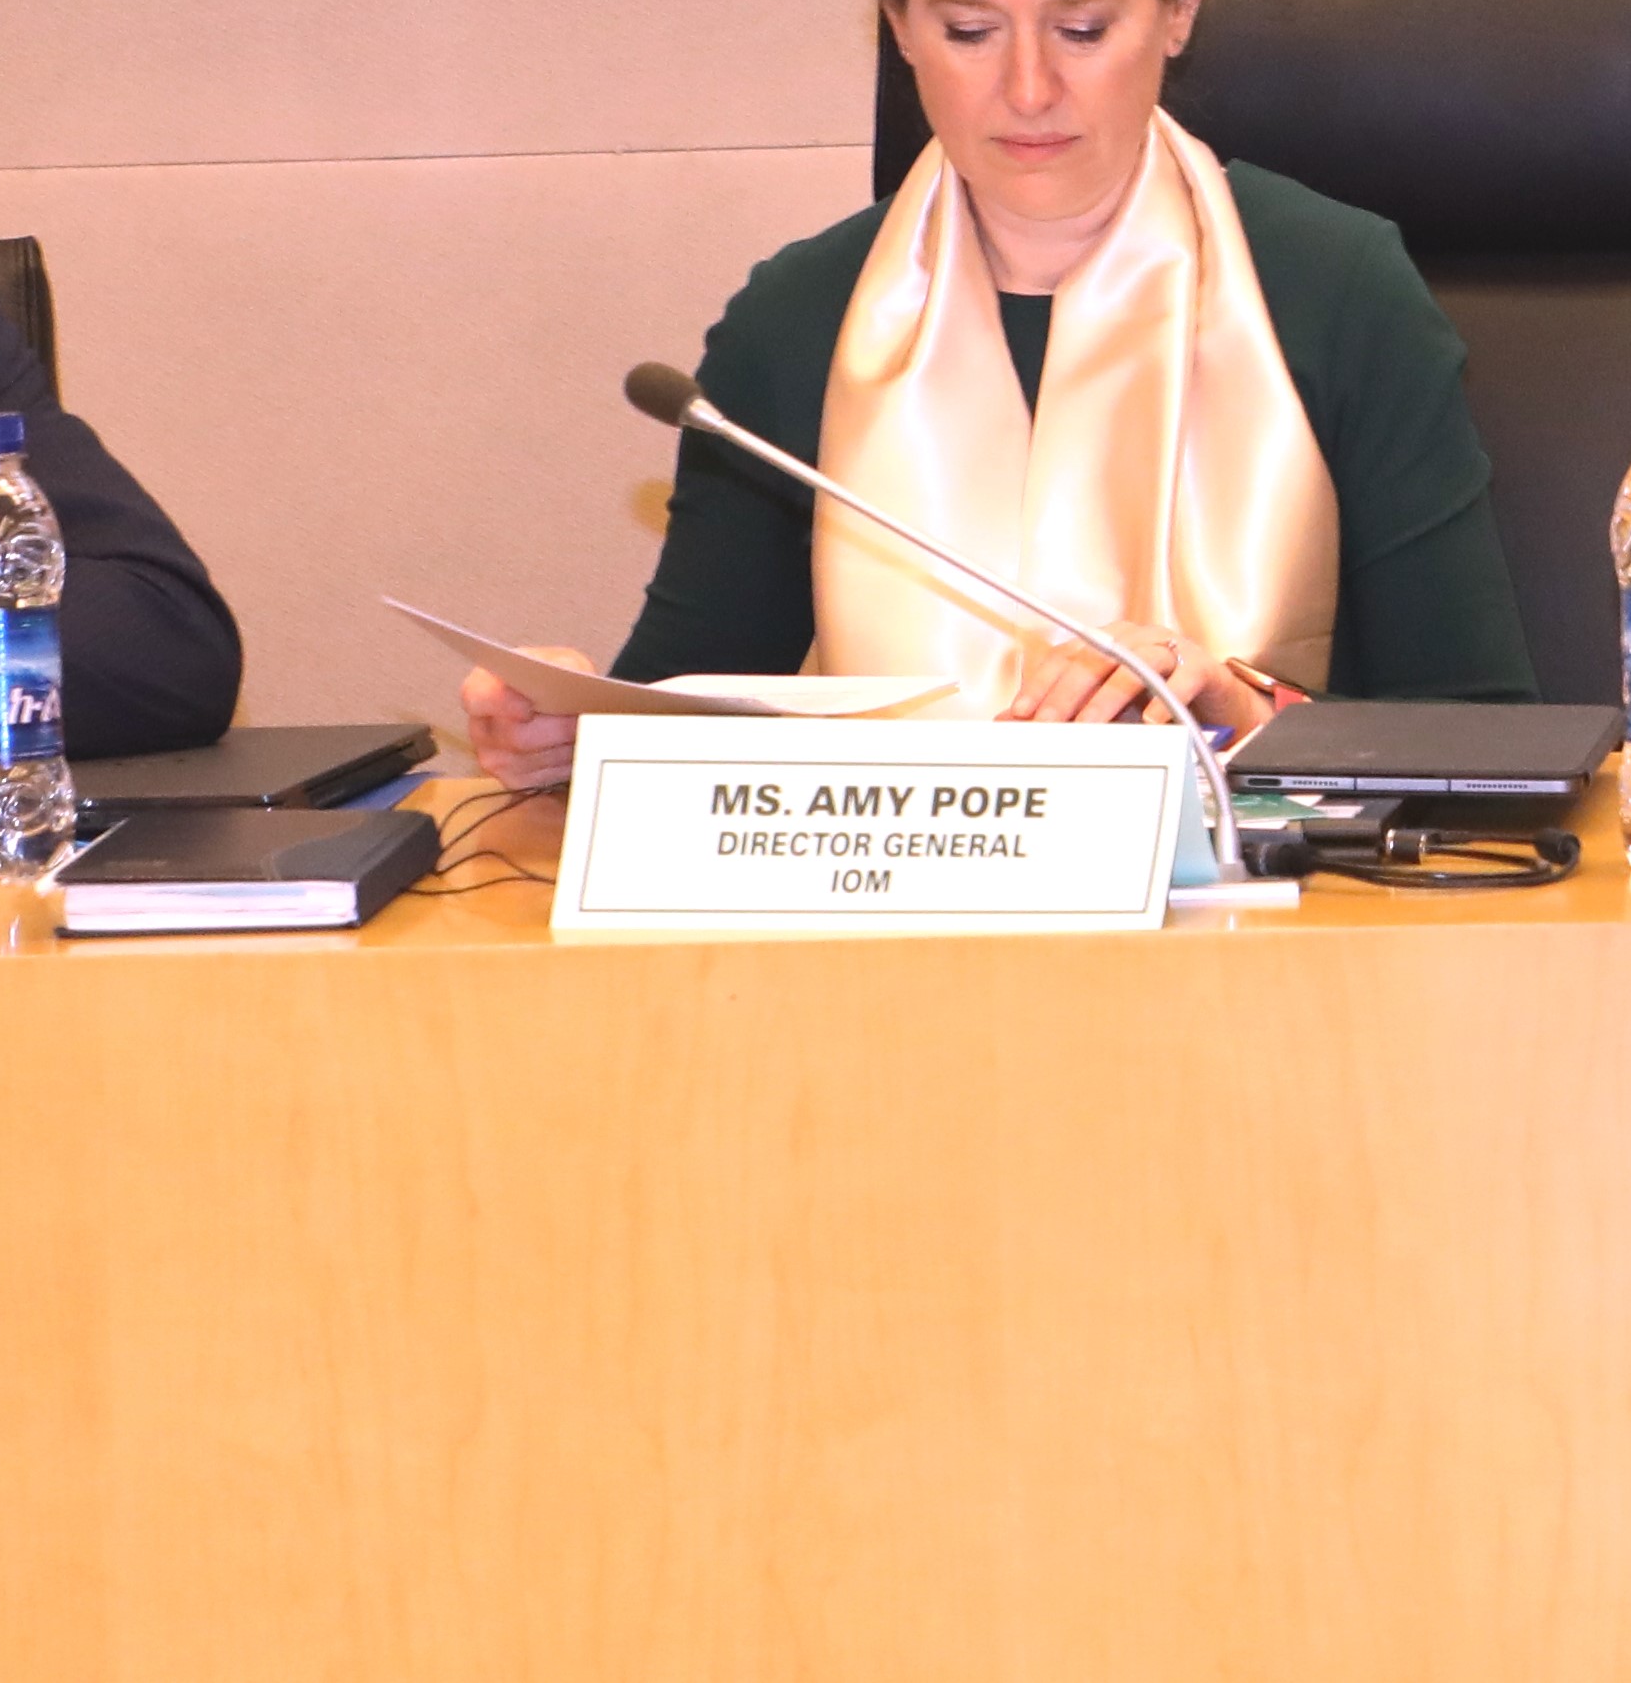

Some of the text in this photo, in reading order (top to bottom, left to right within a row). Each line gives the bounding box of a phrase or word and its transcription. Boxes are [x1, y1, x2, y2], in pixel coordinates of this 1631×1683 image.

[712, 784, 1046, 818] MS. AMY POPE
[718, 832, 1026, 857] DIRECTOR GENERAL
[832, 869, 891, 893] IOM
